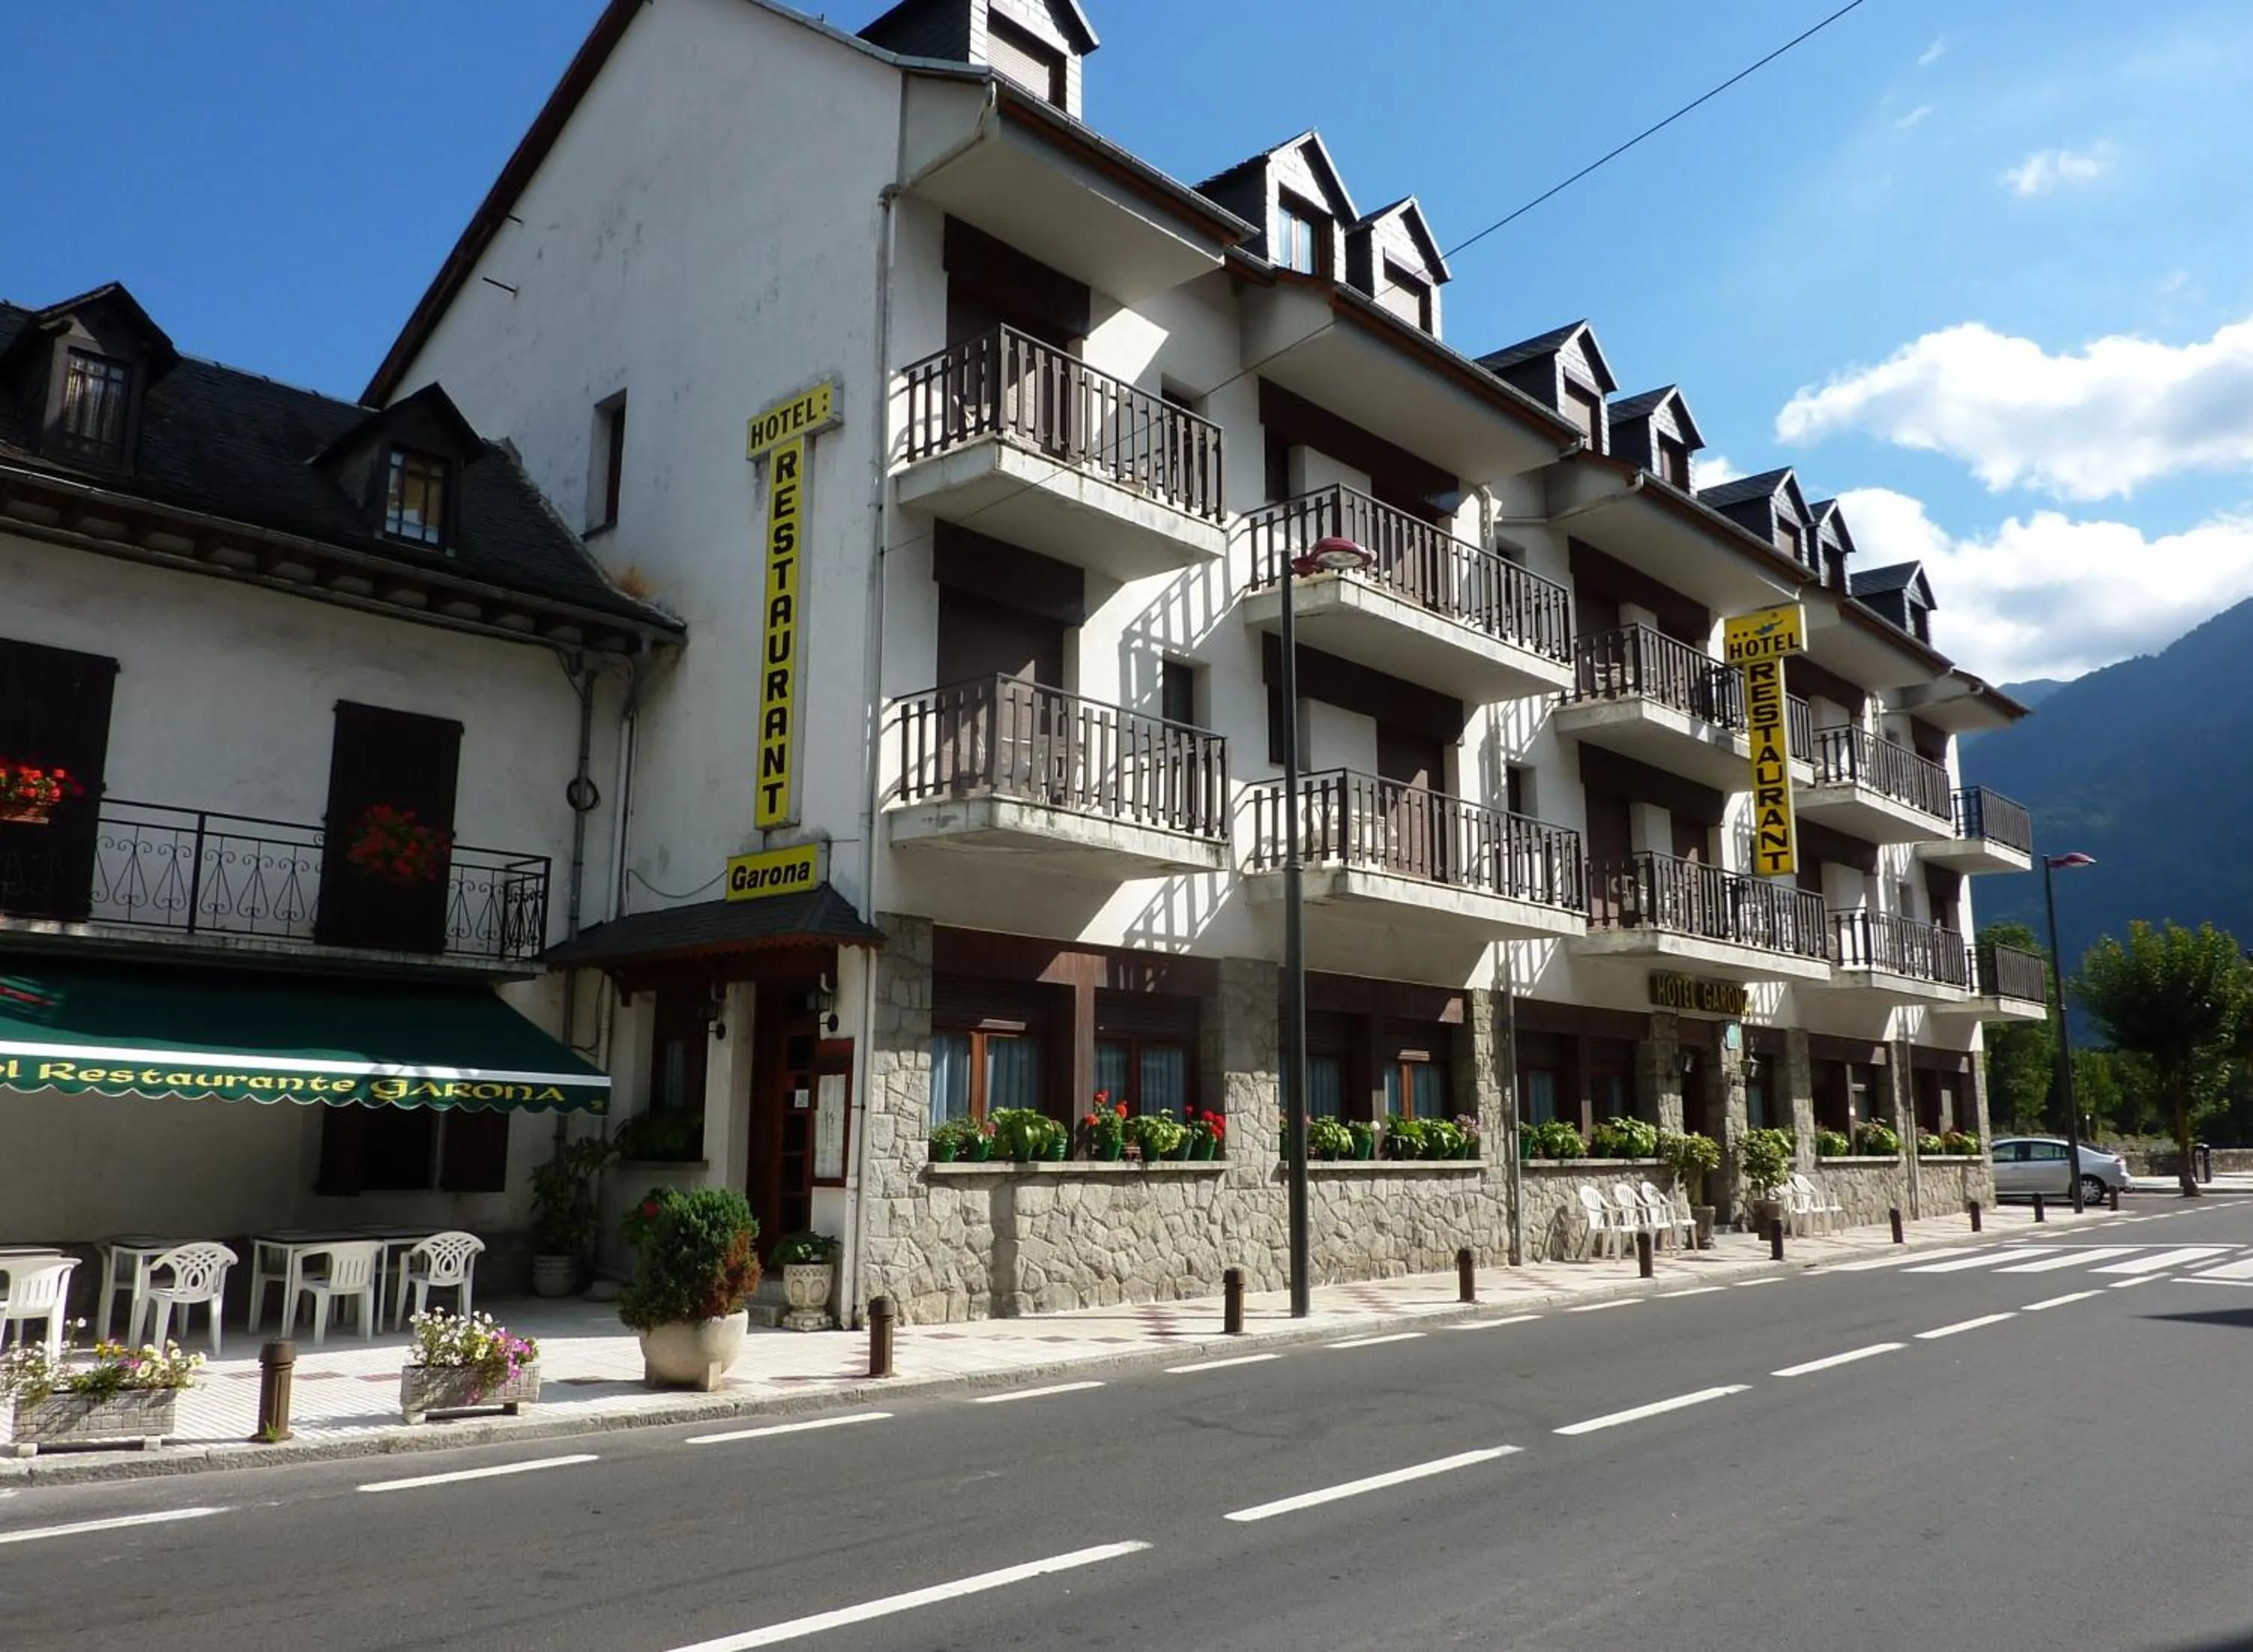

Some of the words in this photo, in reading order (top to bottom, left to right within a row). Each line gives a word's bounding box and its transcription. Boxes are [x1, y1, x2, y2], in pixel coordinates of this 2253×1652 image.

[763, 449, 798, 814] RESTAURANT
[1729, 632, 1800, 662] HOTEL
[1748, 662, 1789, 871] RESTAURANT
[731, 861, 811, 891] Garona
[1657, 975, 1697, 1009] HOTEL
[0, 1060, 21, 1079] l
[38, 1062, 355, 1093] Restaurante
